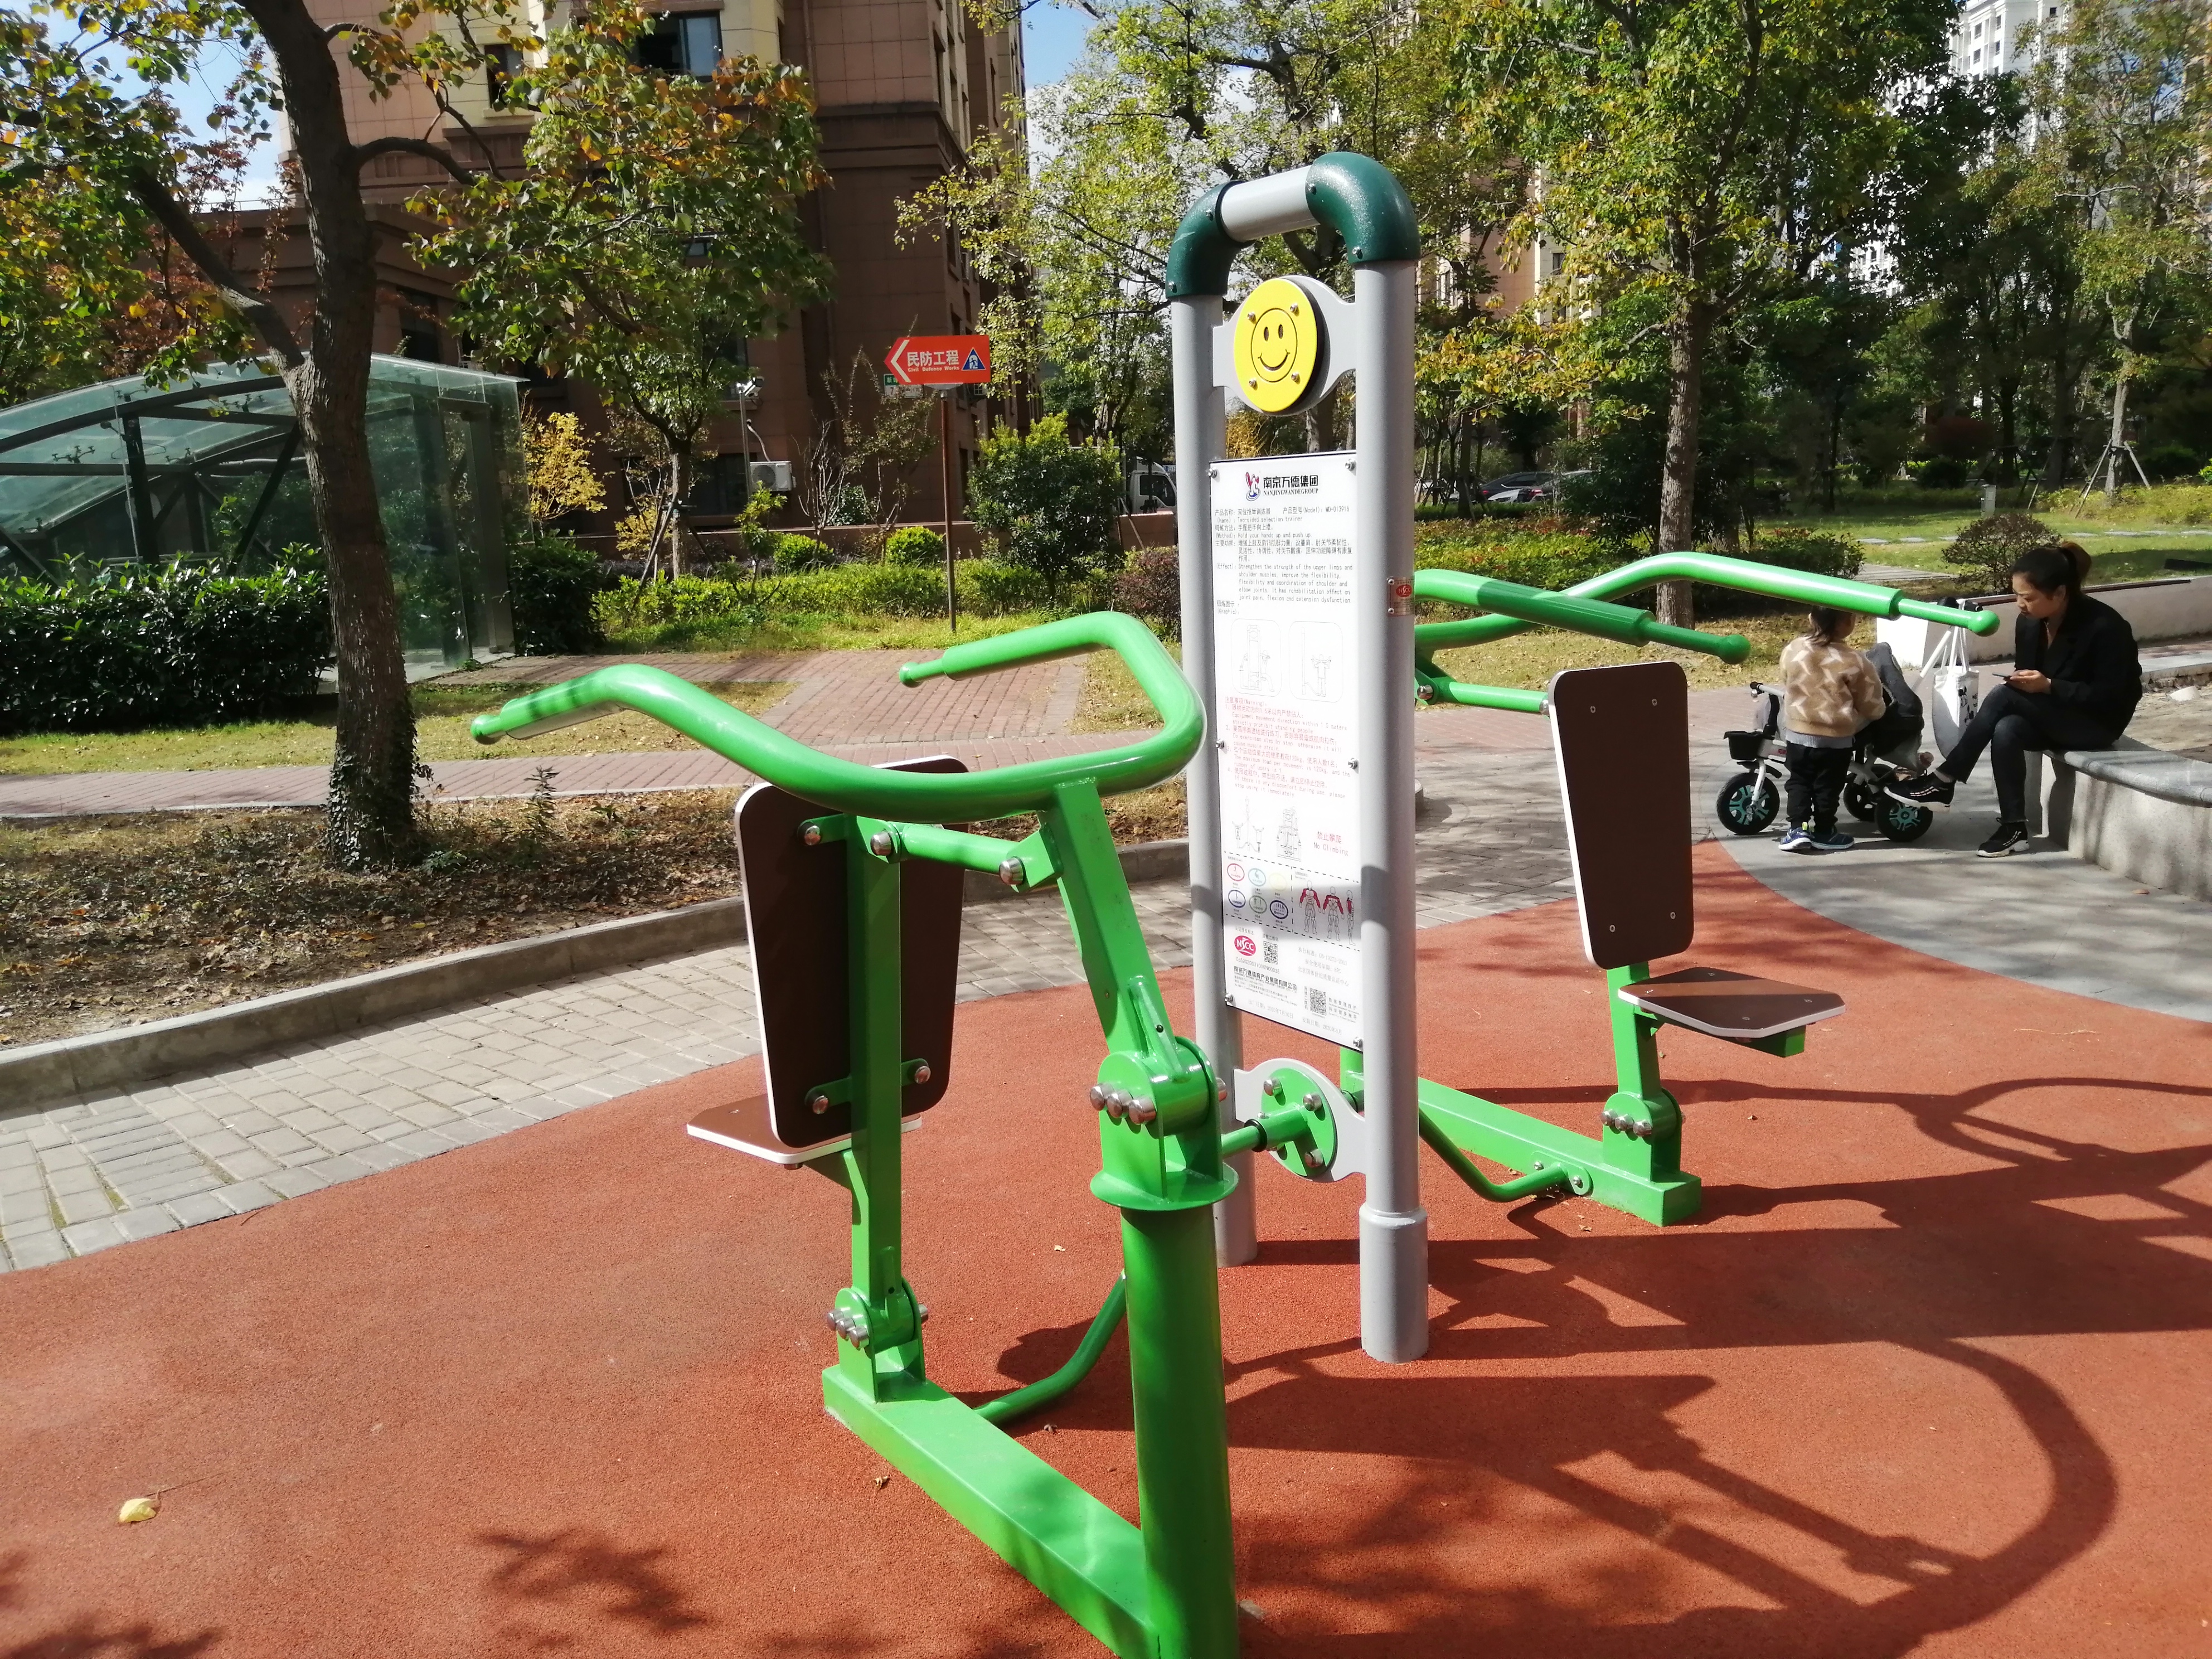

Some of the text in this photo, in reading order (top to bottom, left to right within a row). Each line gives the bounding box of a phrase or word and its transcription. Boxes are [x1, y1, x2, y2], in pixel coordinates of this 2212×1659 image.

[907, 350, 959, 367] 民防工程
[1263, 475, 1318, 488] 南京万德集团
[1317, 831, 1342, 844] 禁止攀爬
[1313, 841, 1348, 857] No Climbing
[1236, 938, 1254, 951] NSCC
